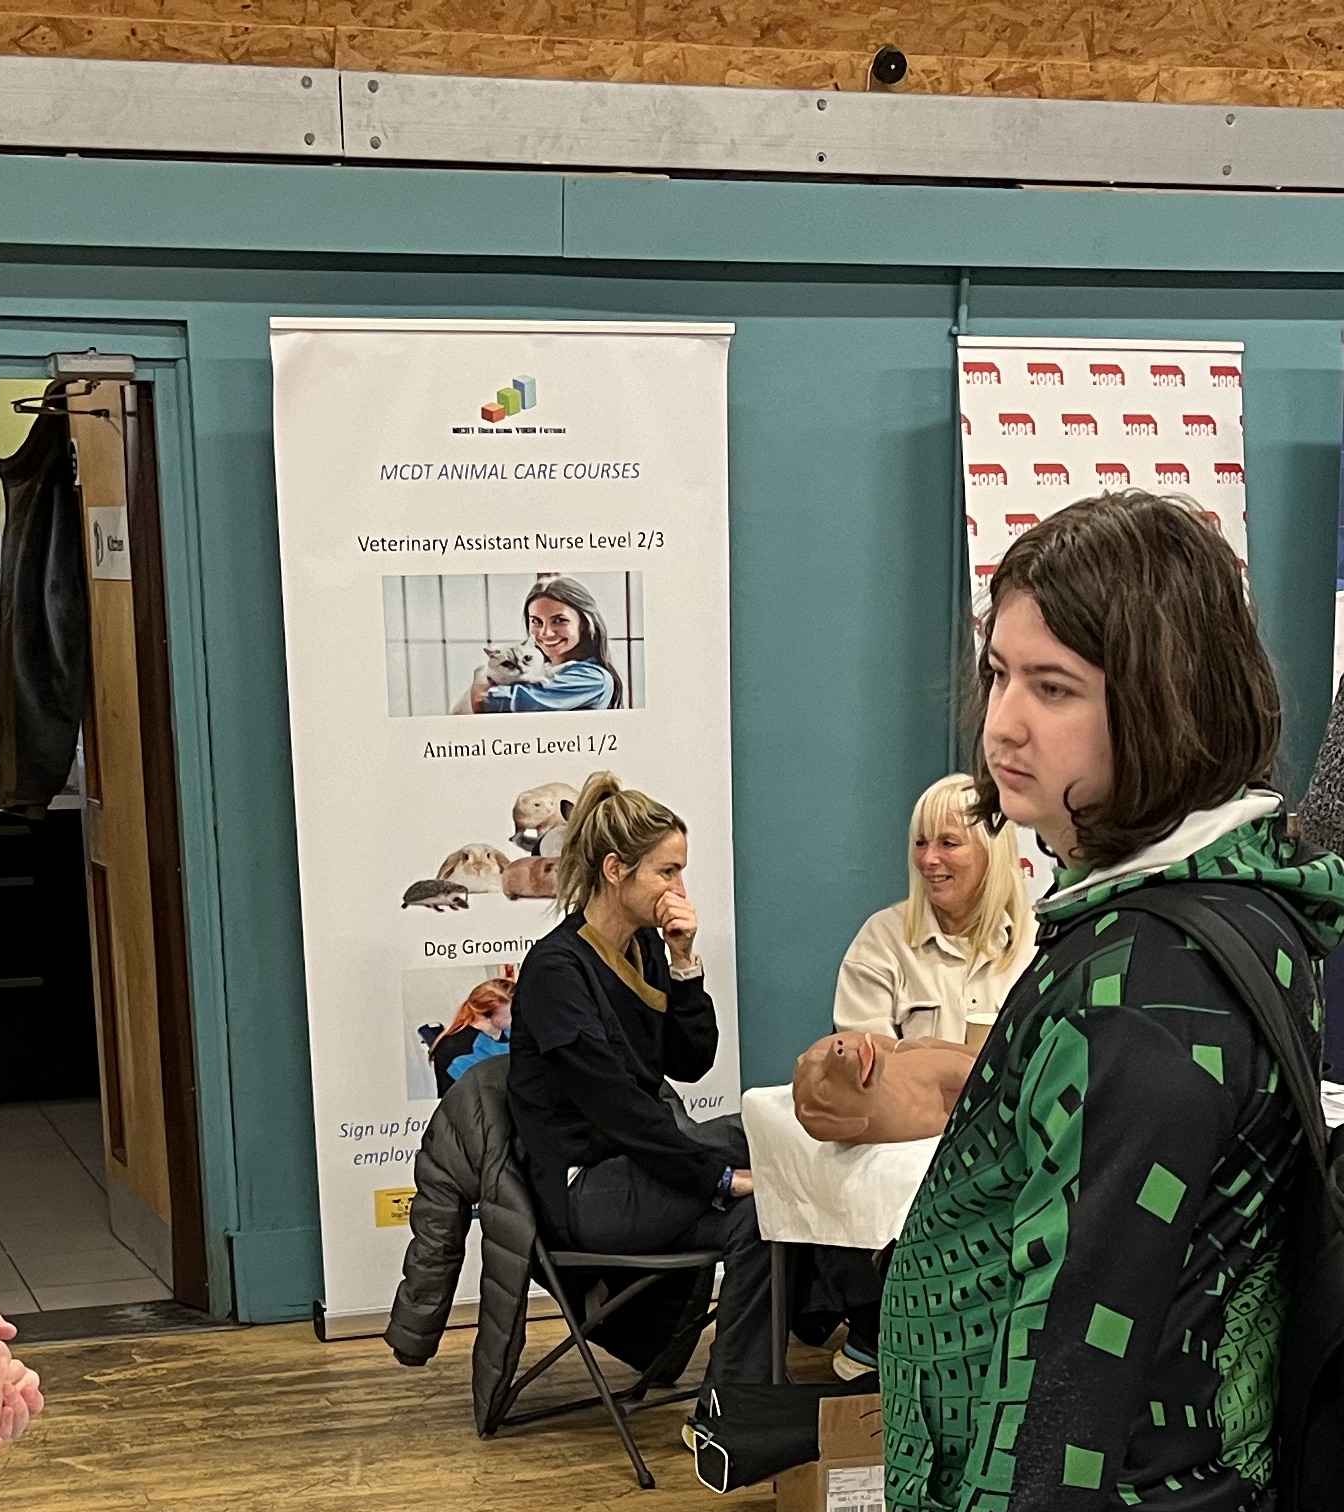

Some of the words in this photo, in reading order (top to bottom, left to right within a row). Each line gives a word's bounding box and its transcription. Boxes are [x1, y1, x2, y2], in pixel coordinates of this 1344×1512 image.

[963, 371, 1000, 384] MODE
[1029, 372, 1063, 385] MODE
[1091, 373, 1124, 385] MODE
[1151, 374, 1185, 387] MODE
[1211, 375, 1241, 387] MODE
[1001, 423, 1035, 435] MODE
[1063, 423, 1097, 435] MODE
[1124, 423, 1157, 435] MODE
[1184, 423, 1217, 435] MODE
[380, 464, 434, 481] MCDT
[437, 464, 508, 481] ANIMAL
[514, 463, 558, 480] CARE
[563, 463, 641, 480] COURSES
[970, 473, 1007, 485] MODE
[1036, 473, 1069, 485] MODE
[1098, 473, 1130, 484] MODE
[1157, 473, 1189, 484] MODE
[1216, 473, 1244, 484] MODE
[358, 535, 448, 555] Veterinary
[454, 534, 530, 551] Assistant
[536, 533, 584, 550] Nurse
[589, 531, 632, 549] Level
[637, 530, 665, 550] 2/3
[423, 739, 486, 758] Animal
[492, 738, 530, 756] Care
[536, 735, 581, 753] Level
[587, 734, 618, 756] 1/2
[424, 941, 457, 959] Dog
[690, 1094, 724, 1111] your
[339, 1120, 374, 1141] Sign
[379, 1123, 399, 1139] up
[403, 1117, 428, 1138] for
